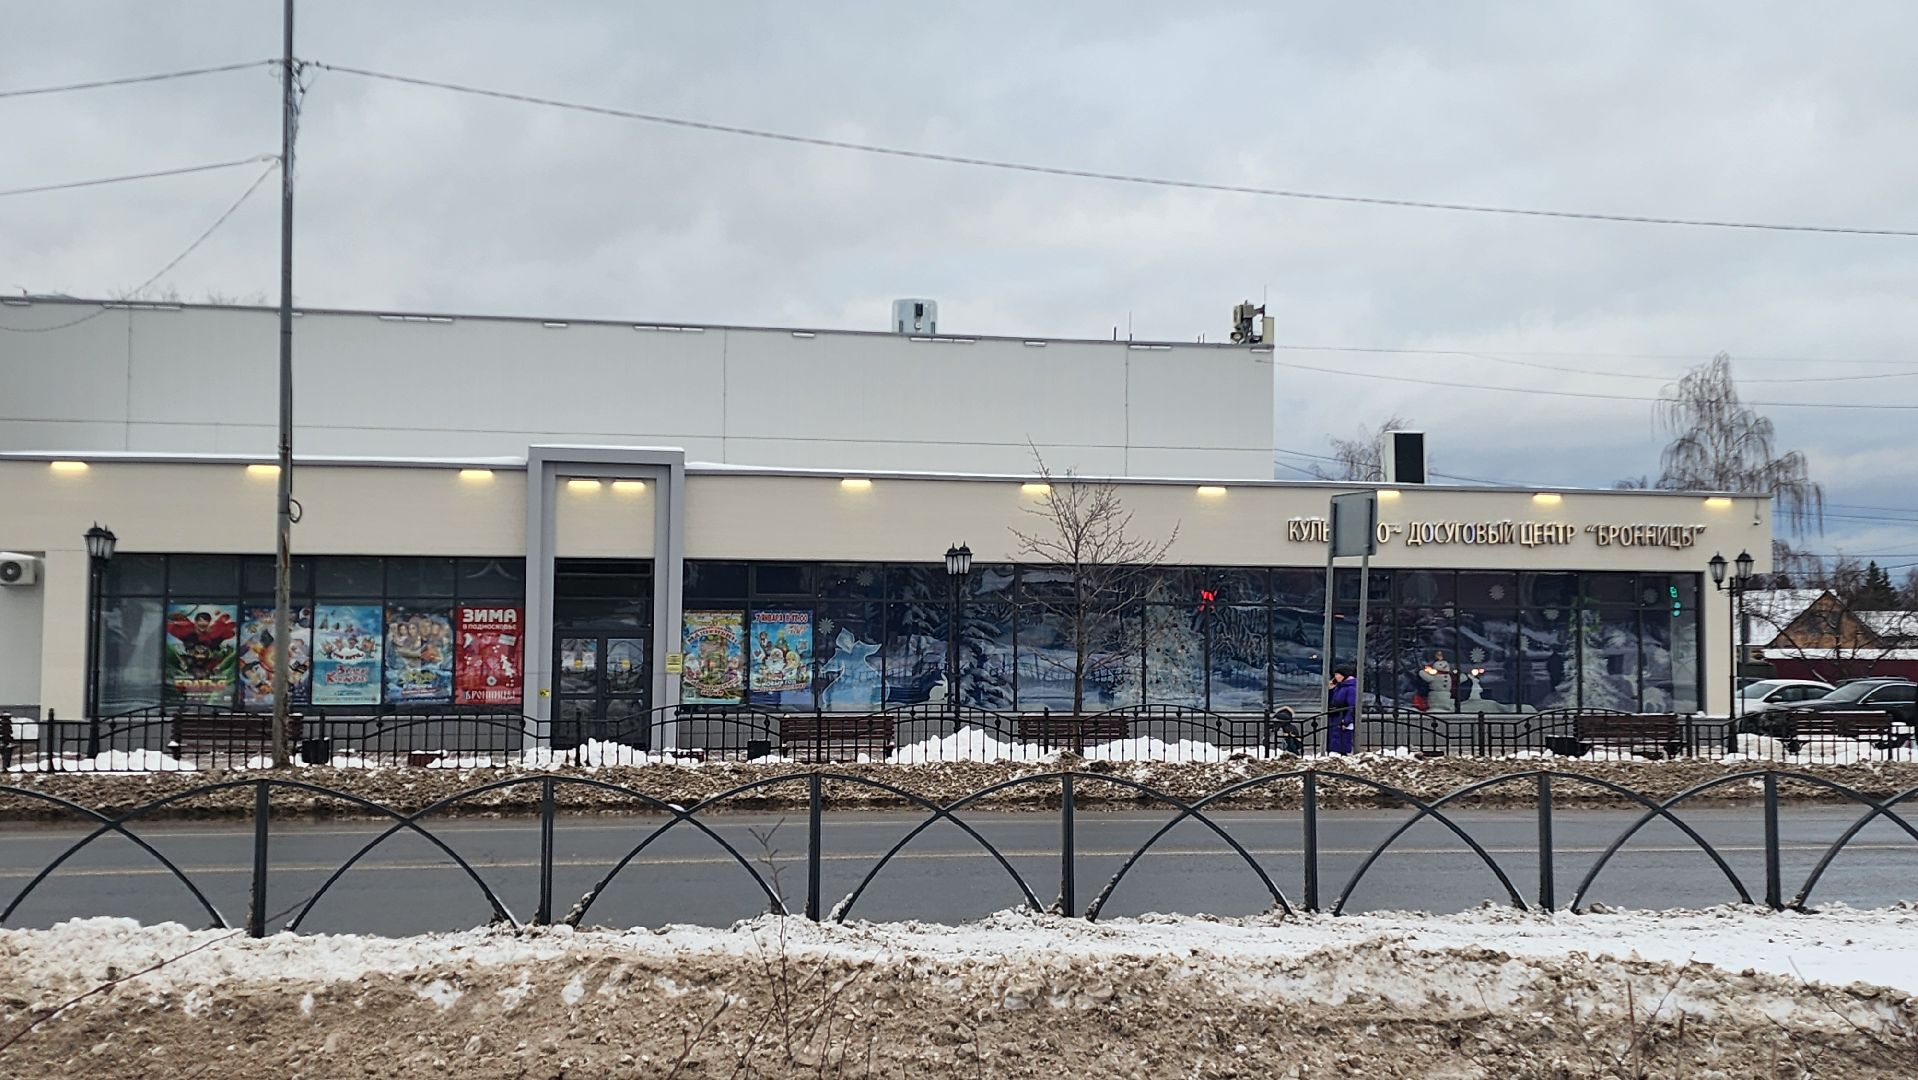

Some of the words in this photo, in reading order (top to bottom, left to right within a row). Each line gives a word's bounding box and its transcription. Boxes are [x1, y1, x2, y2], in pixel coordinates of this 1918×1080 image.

[1287, 519, 1402, 543] КУЛЬО-
[1405, 519, 1515, 547] ДОСУГОВЫЙ
[1519, 520, 1577, 548] ЦЕНТР
[462, 608, 518, 623] ЗИМА
